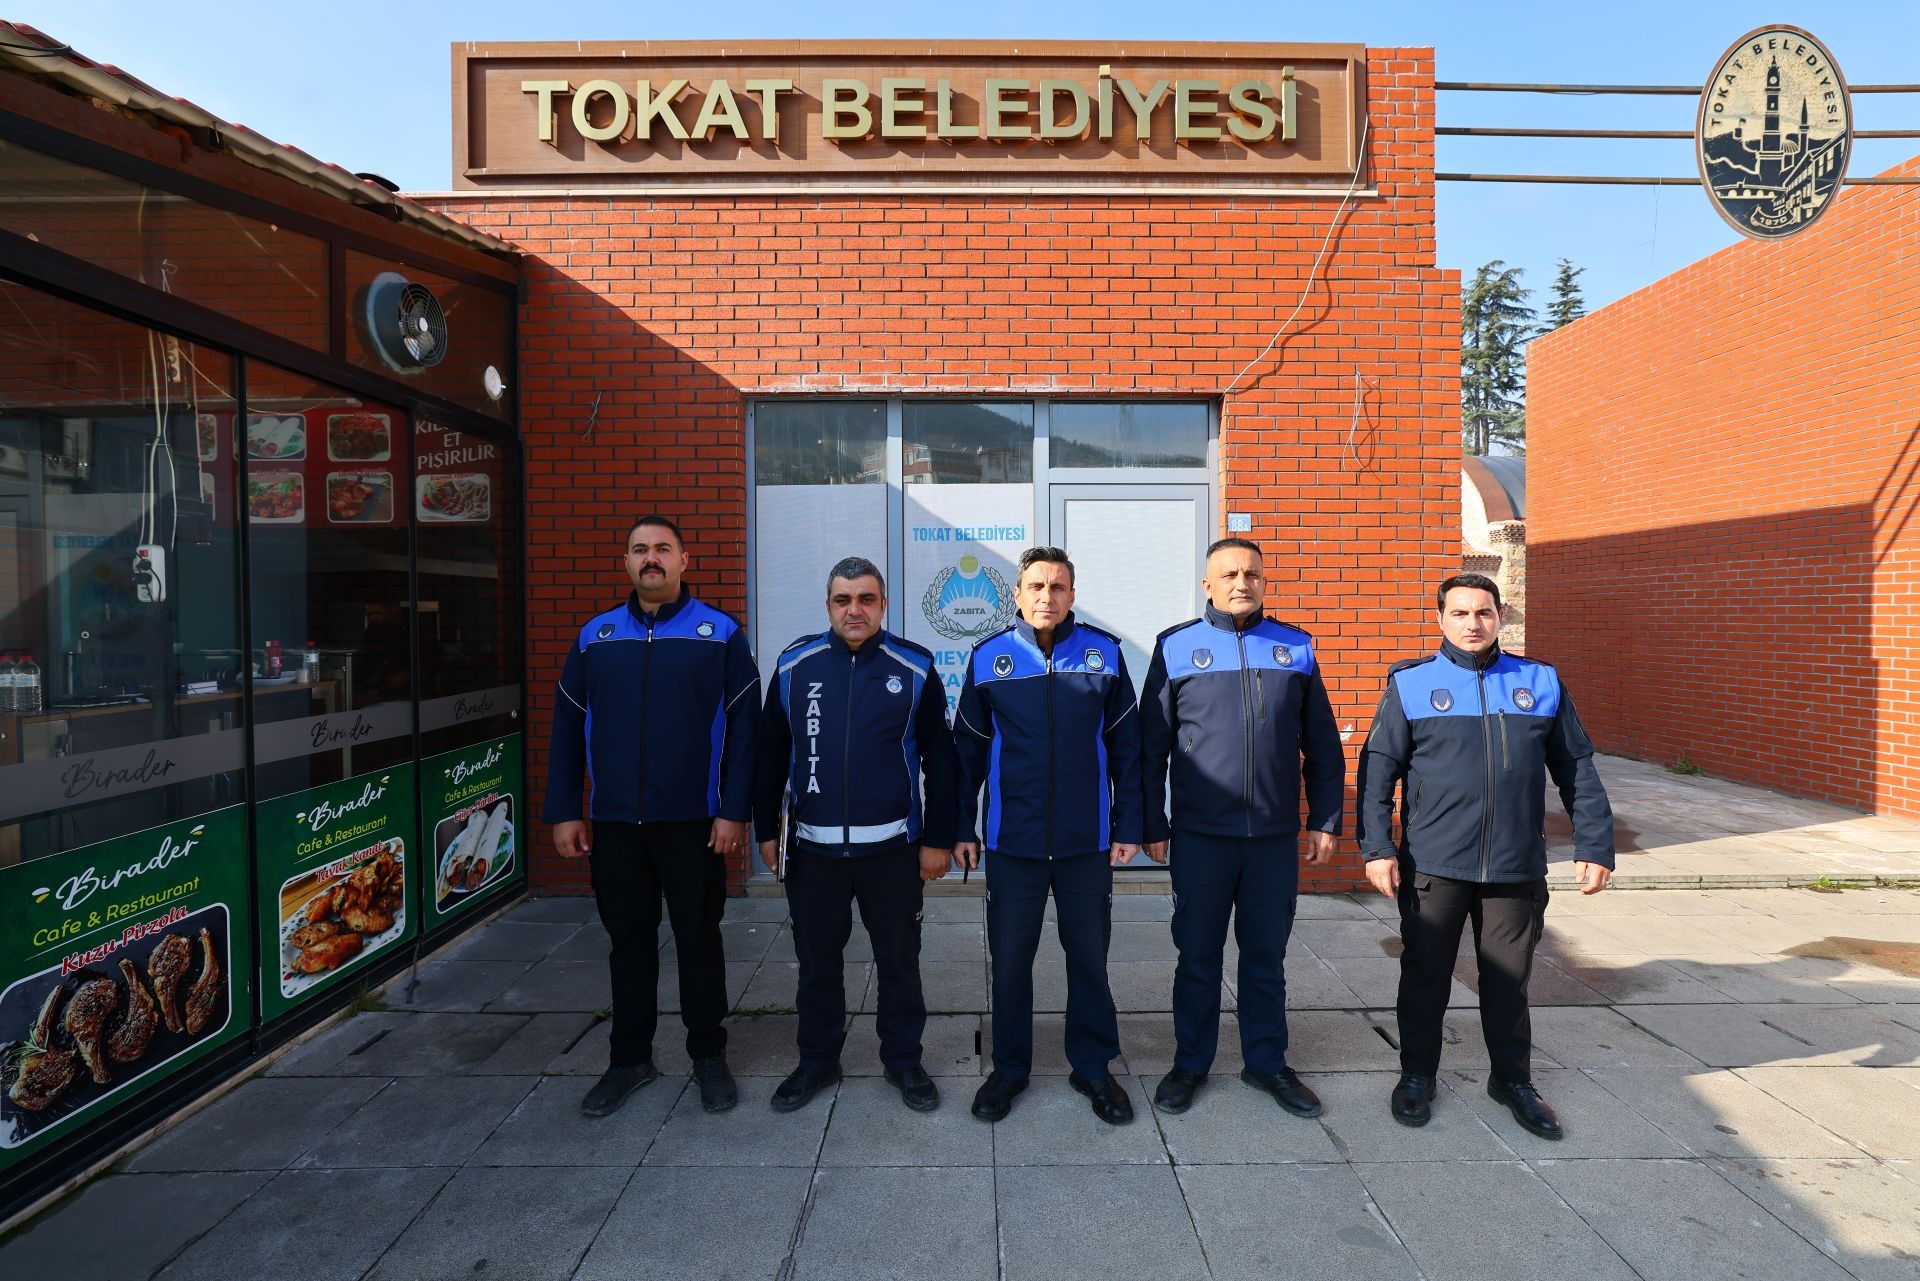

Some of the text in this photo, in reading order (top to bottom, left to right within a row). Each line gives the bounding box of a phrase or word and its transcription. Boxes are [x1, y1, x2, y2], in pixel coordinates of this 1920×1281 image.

[521, 65, 1296, 142] TOKAT BELEDİYESİ
[1711, 60, 1745, 126] TOKAT
[443, 431, 463, 448] ET
[912, 524, 1025, 541] TOKAT BELEDİYESİ
[806, 682, 823, 794] ZABITA
[61, 748, 176, 798] Birader
[445, 775, 502, 803] Cafe & Restaurant
[452, 747, 502, 785] Birader
[308, 782, 387, 832] Birader
[296, 815, 388, 856] Cafe & Restaurant
[55, 836, 200, 911] Birader
[315, 839, 383, 883] Tavuk Kanat
[33, 876, 200, 947] Cafe & Restaurant
[61, 904, 189, 976] Kuzu Pirzola
